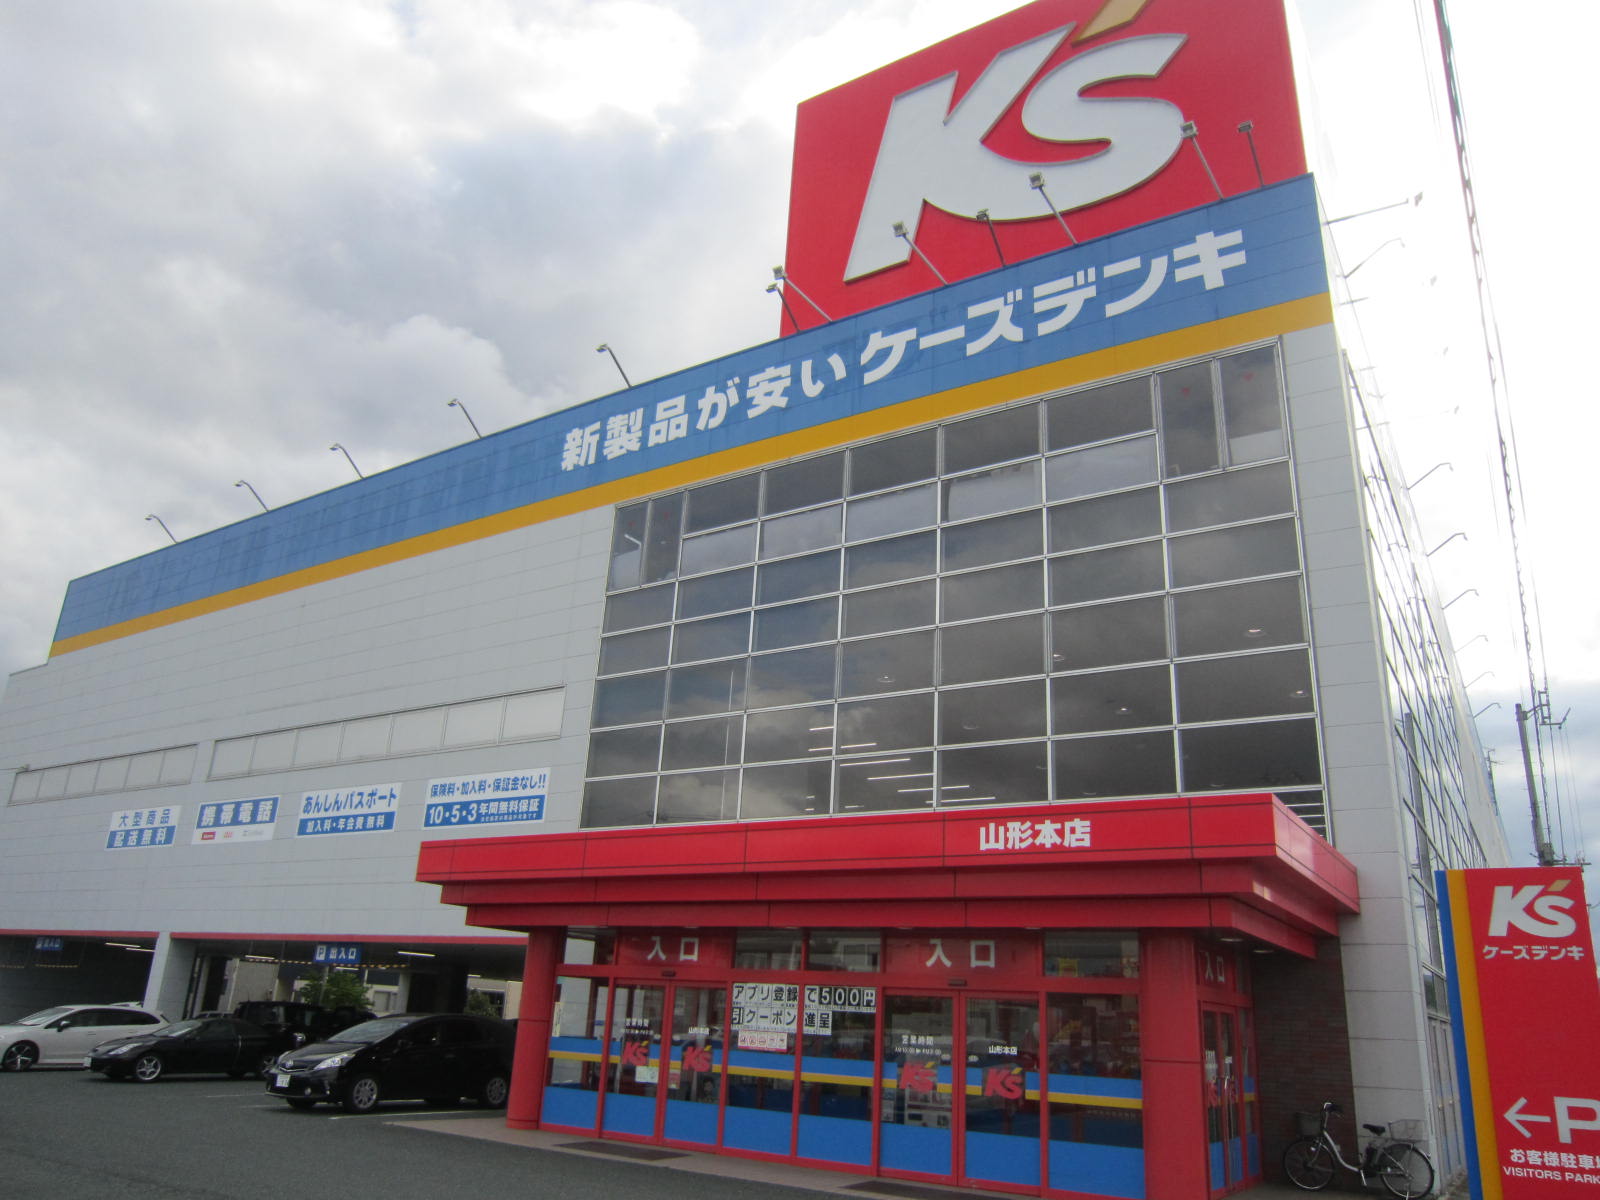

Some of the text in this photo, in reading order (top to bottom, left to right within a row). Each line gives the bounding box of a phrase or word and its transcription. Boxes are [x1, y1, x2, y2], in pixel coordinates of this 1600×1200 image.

[561, 228, 1248, 472] 新製品が安いケーズデンキ
[979, 818, 1091, 851] 山形本店
[647, 936, 699, 961] 入口
[925, 938, 996, 968] 入口
[1482, 945, 1585, 960] ケーズデンキ
[734, 984, 876, 1006] アプリ登録 で500円
[1503, 1166, 1562, 1181] VISITORS
